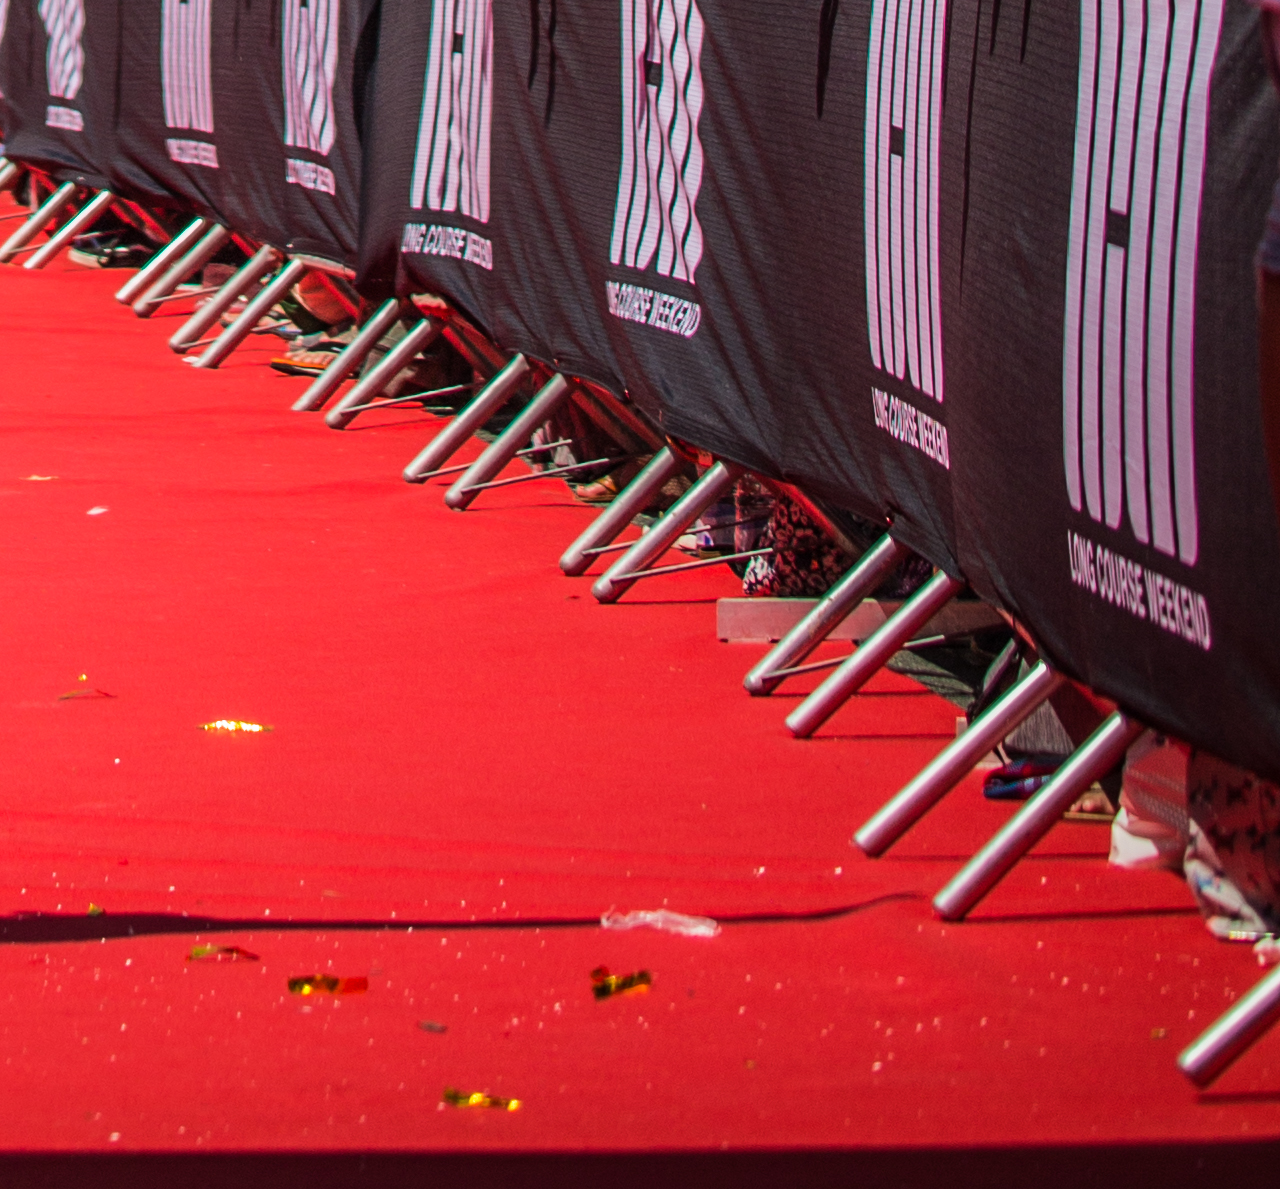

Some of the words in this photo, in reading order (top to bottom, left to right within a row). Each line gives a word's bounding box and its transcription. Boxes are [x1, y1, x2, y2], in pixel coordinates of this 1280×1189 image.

[647, 290, 702, 339] WEEKEND
[888, 394, 920, 449] COURSE
[1067, 528, 1097, 594] LONG
[1096, 543, 1147, 619] COURSE
[1143, 567, 1211, 651] WEEKEND
